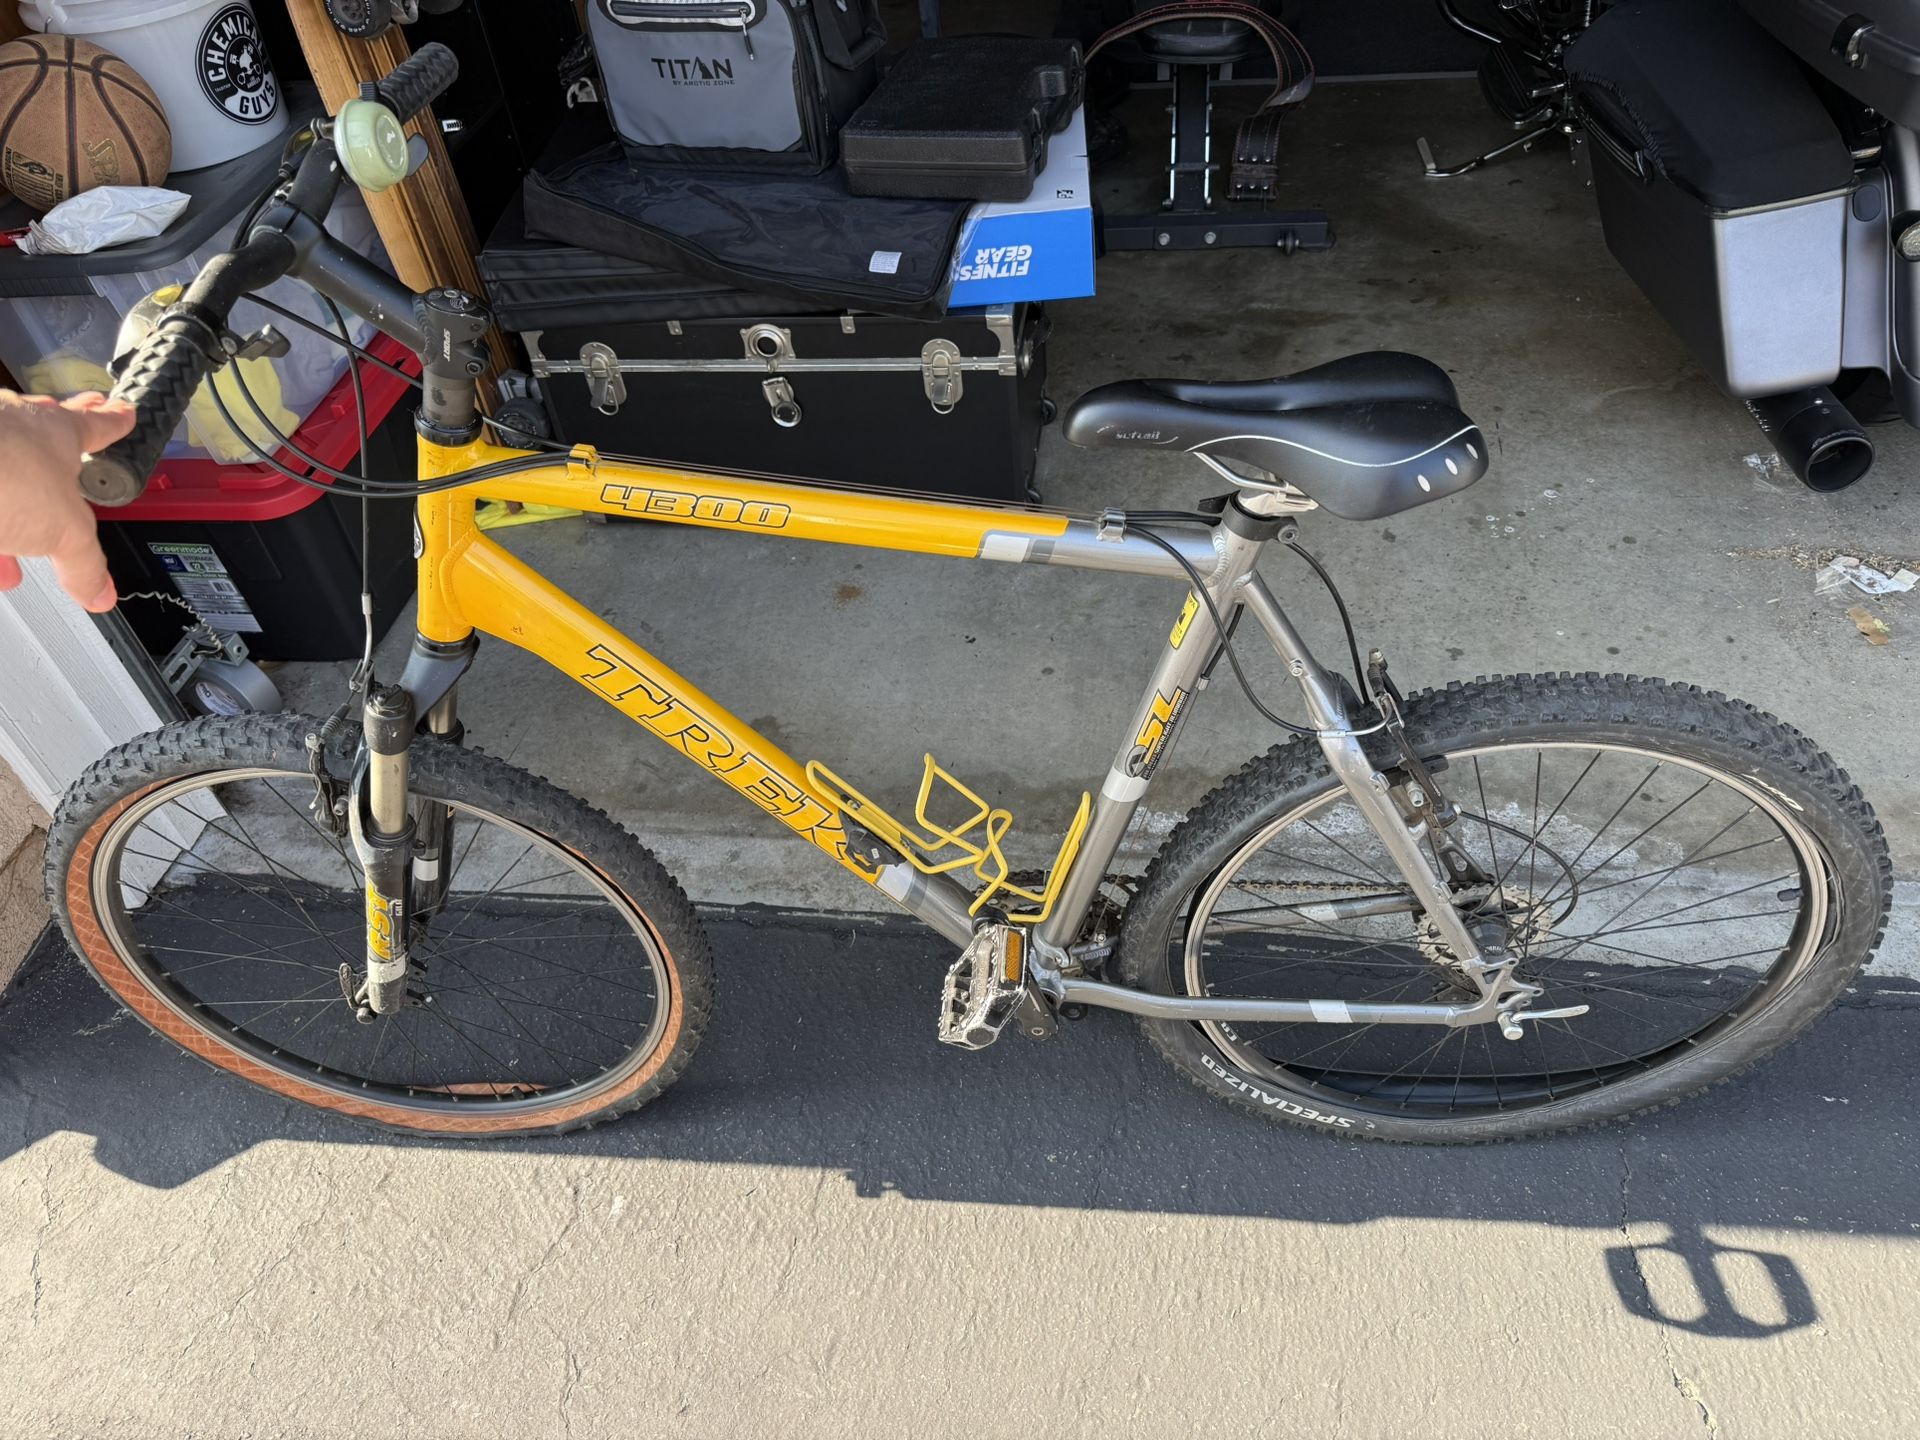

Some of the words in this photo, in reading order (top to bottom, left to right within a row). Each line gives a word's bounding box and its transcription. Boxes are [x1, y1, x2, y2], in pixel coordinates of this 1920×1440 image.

[206, 14, 265, 82] CHEMICAL
[651, 56, 734, 80] TITAN
[239, 80, 275, 115] GUYS
[975, 244, 1033, 264] GEAR
[443, 328, 451, 362] SPORT
[600, 483, 792, 528] 4300
[581, 643, 848, 860] TREK
[1133, 685, 1182, 765] SL
[367, 880, 392, 960] RST
[1201, 1053, 1355, 1128] SPECIALIZED
